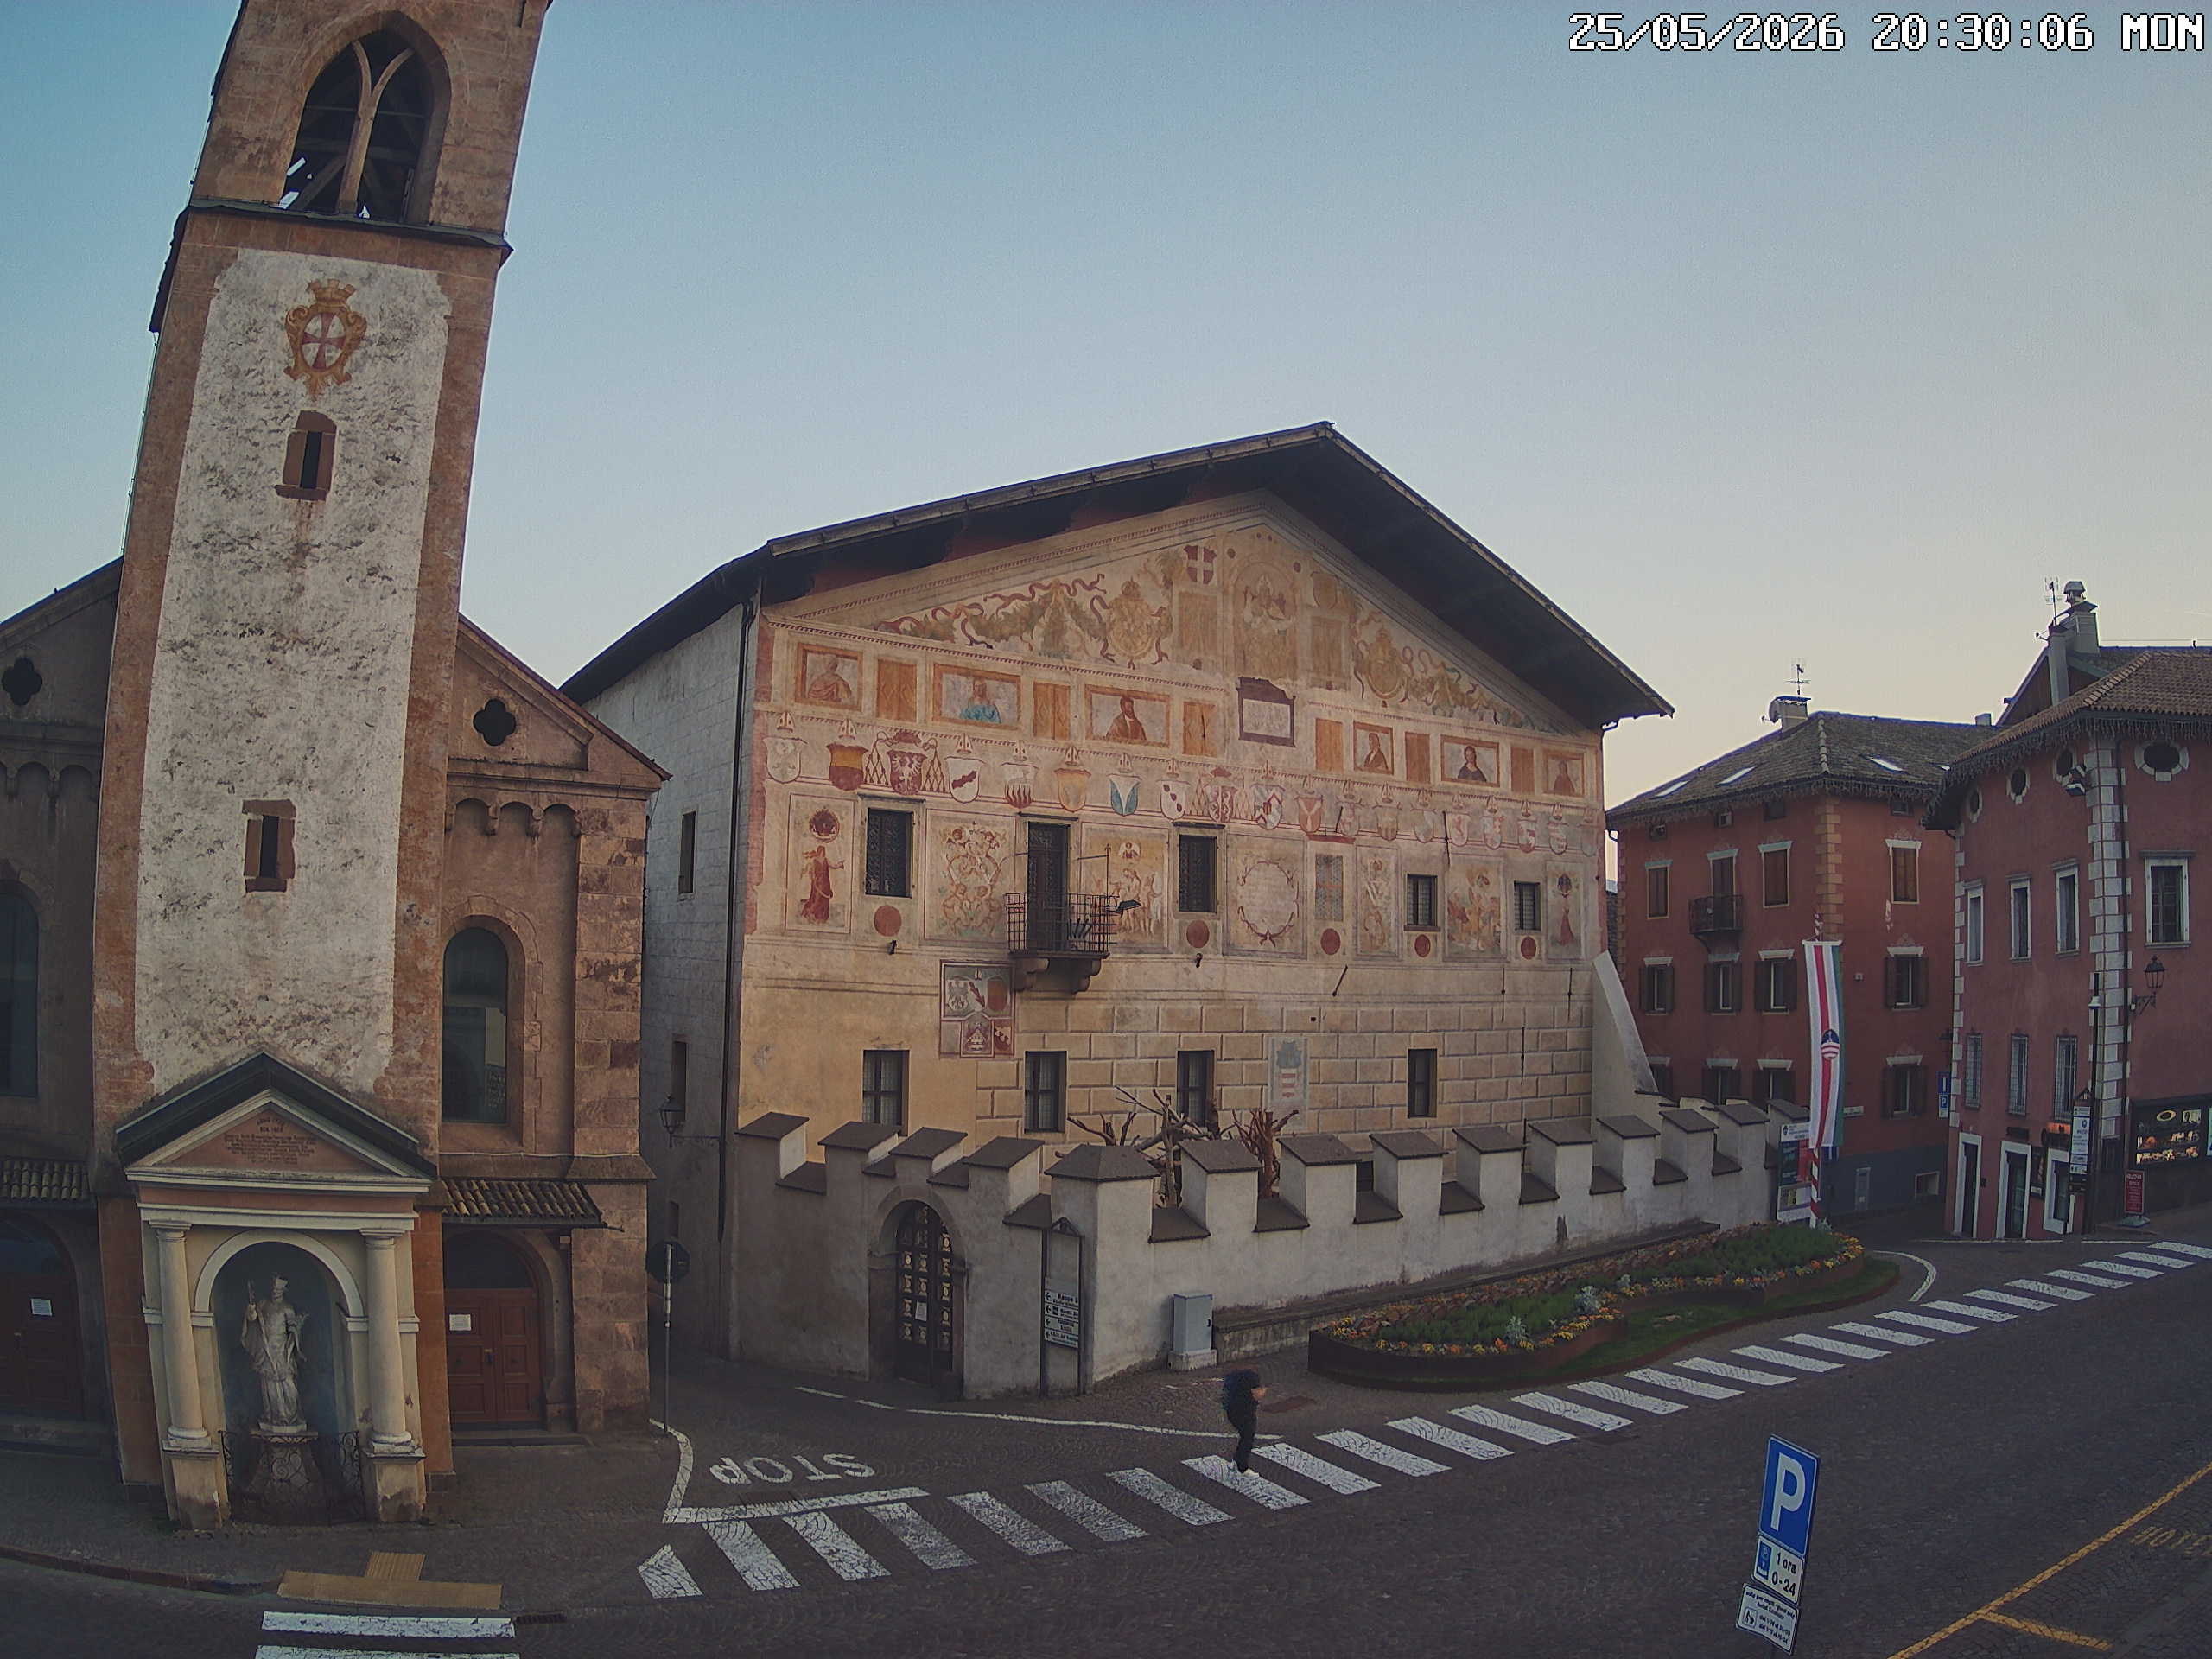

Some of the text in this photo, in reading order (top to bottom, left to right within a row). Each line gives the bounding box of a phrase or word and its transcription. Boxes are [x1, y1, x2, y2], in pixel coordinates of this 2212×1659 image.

[709, 1452, 876, 1485] STOP
[1770, 1452, 1806, 1531] P
[1777, 1552, 1796, 1574] 1 ora
[1771, 1571, 1796, 1597] 0-24
